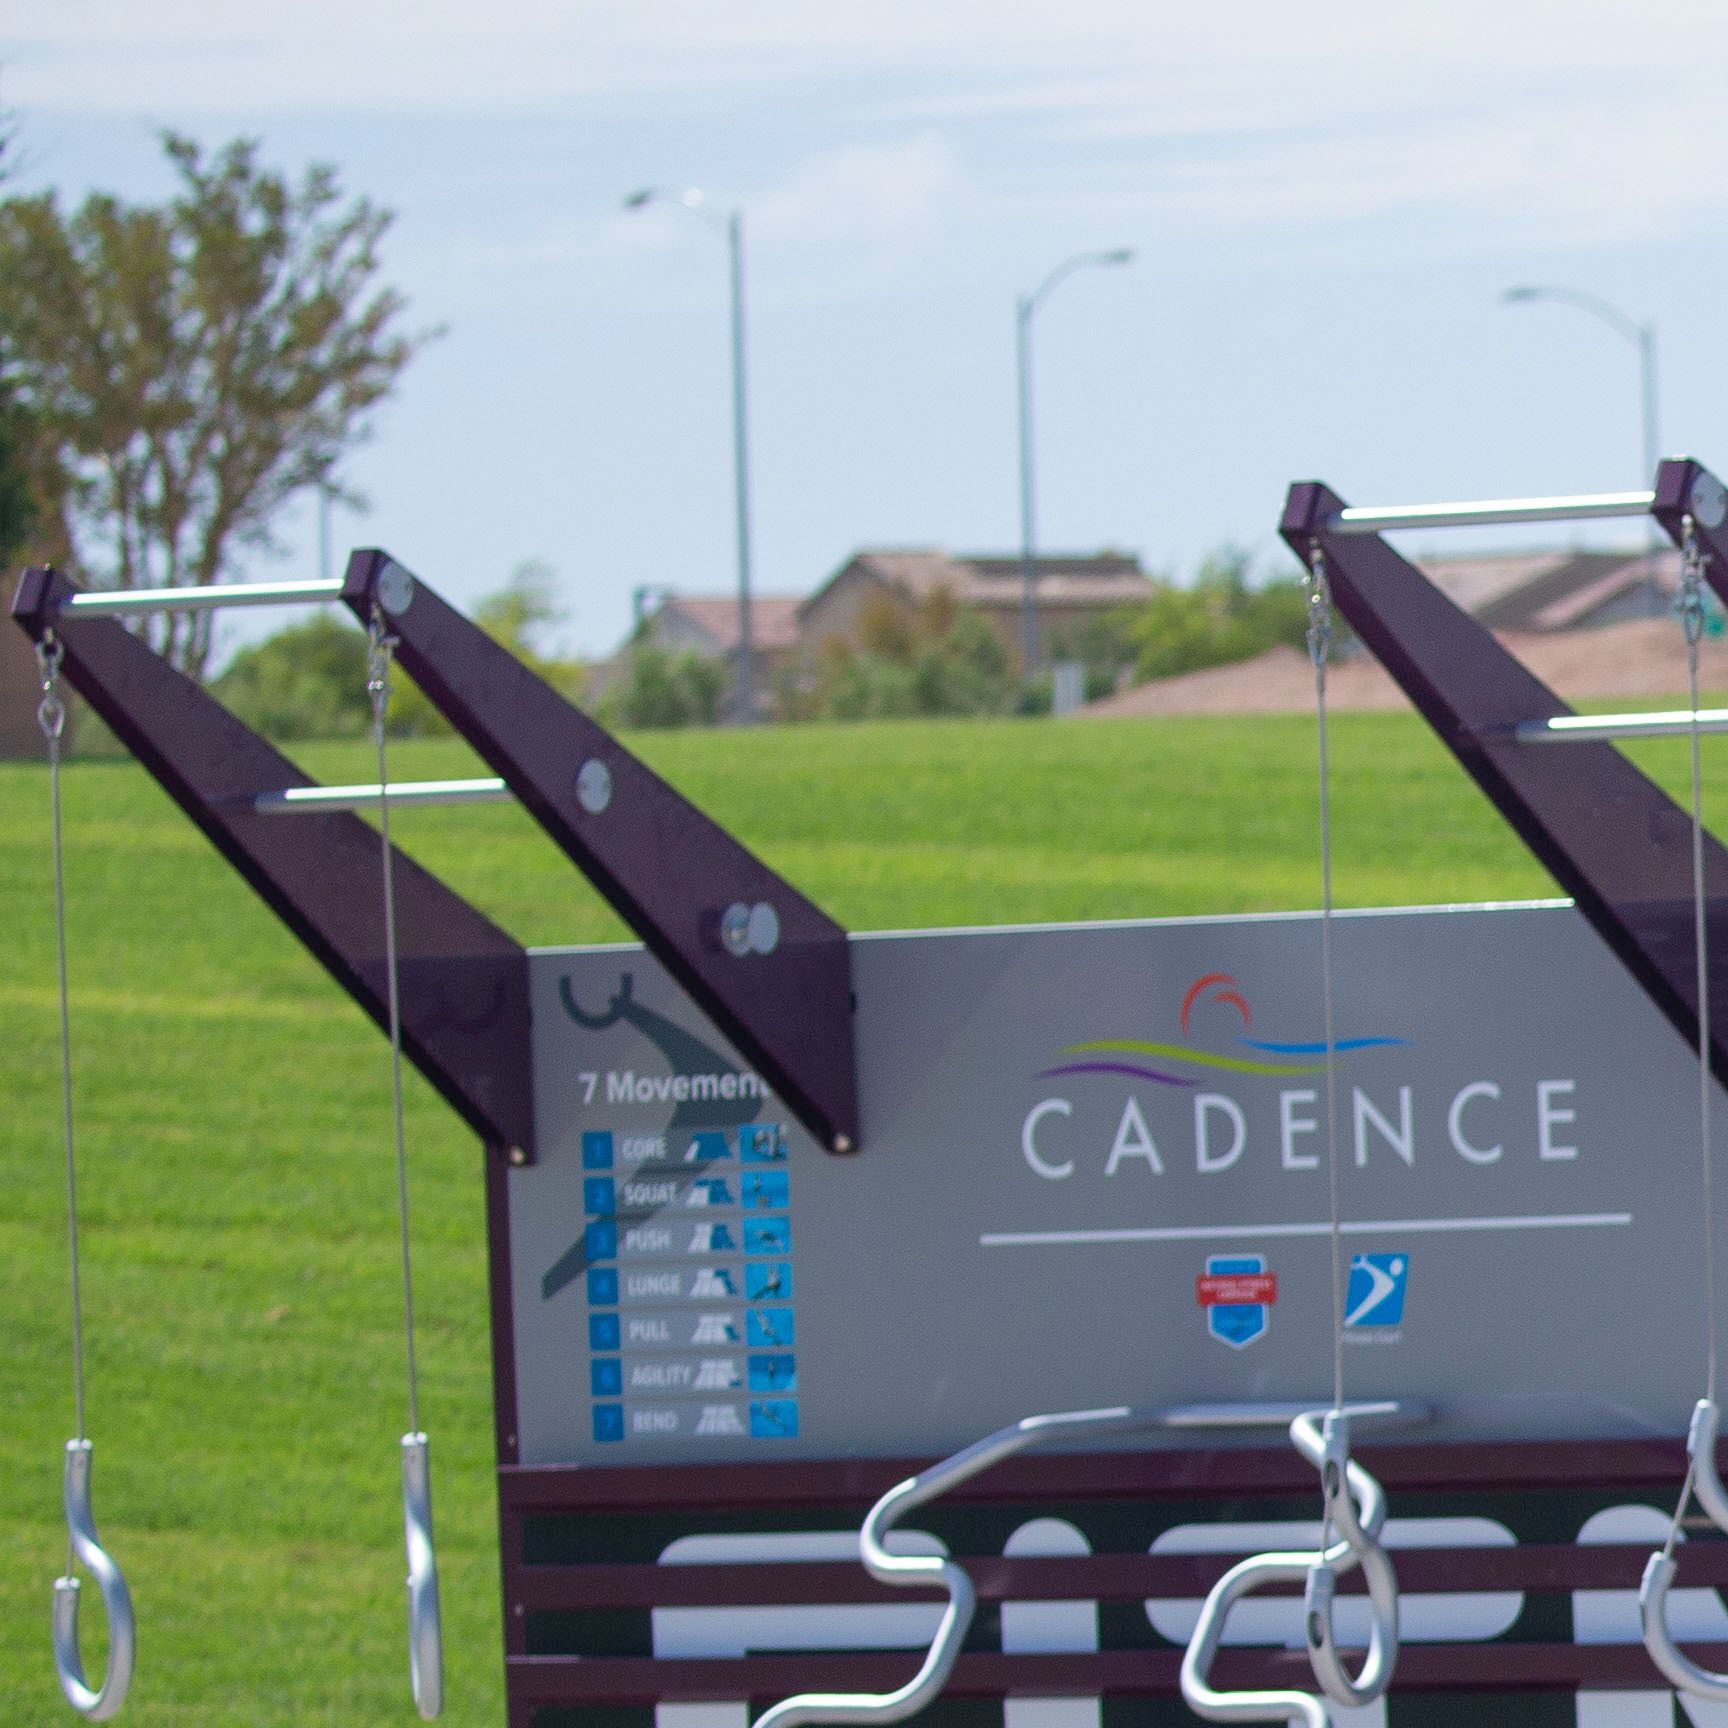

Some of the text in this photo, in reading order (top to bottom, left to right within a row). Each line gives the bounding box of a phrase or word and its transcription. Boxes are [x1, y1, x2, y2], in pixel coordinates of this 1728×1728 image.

[579, 1072, 600, 1104] 7
[1021, 1079, 1580, 1180] CADENCE
[624, 1182, 677, 1206] SQUAT
[626, 1228, 673, 1252] PUSH
[628, 1273, 680, 1297] LUNGE
[629, 1320, 669, 1342] PULL
[631, 1363, 691, 1388] AGILITY
